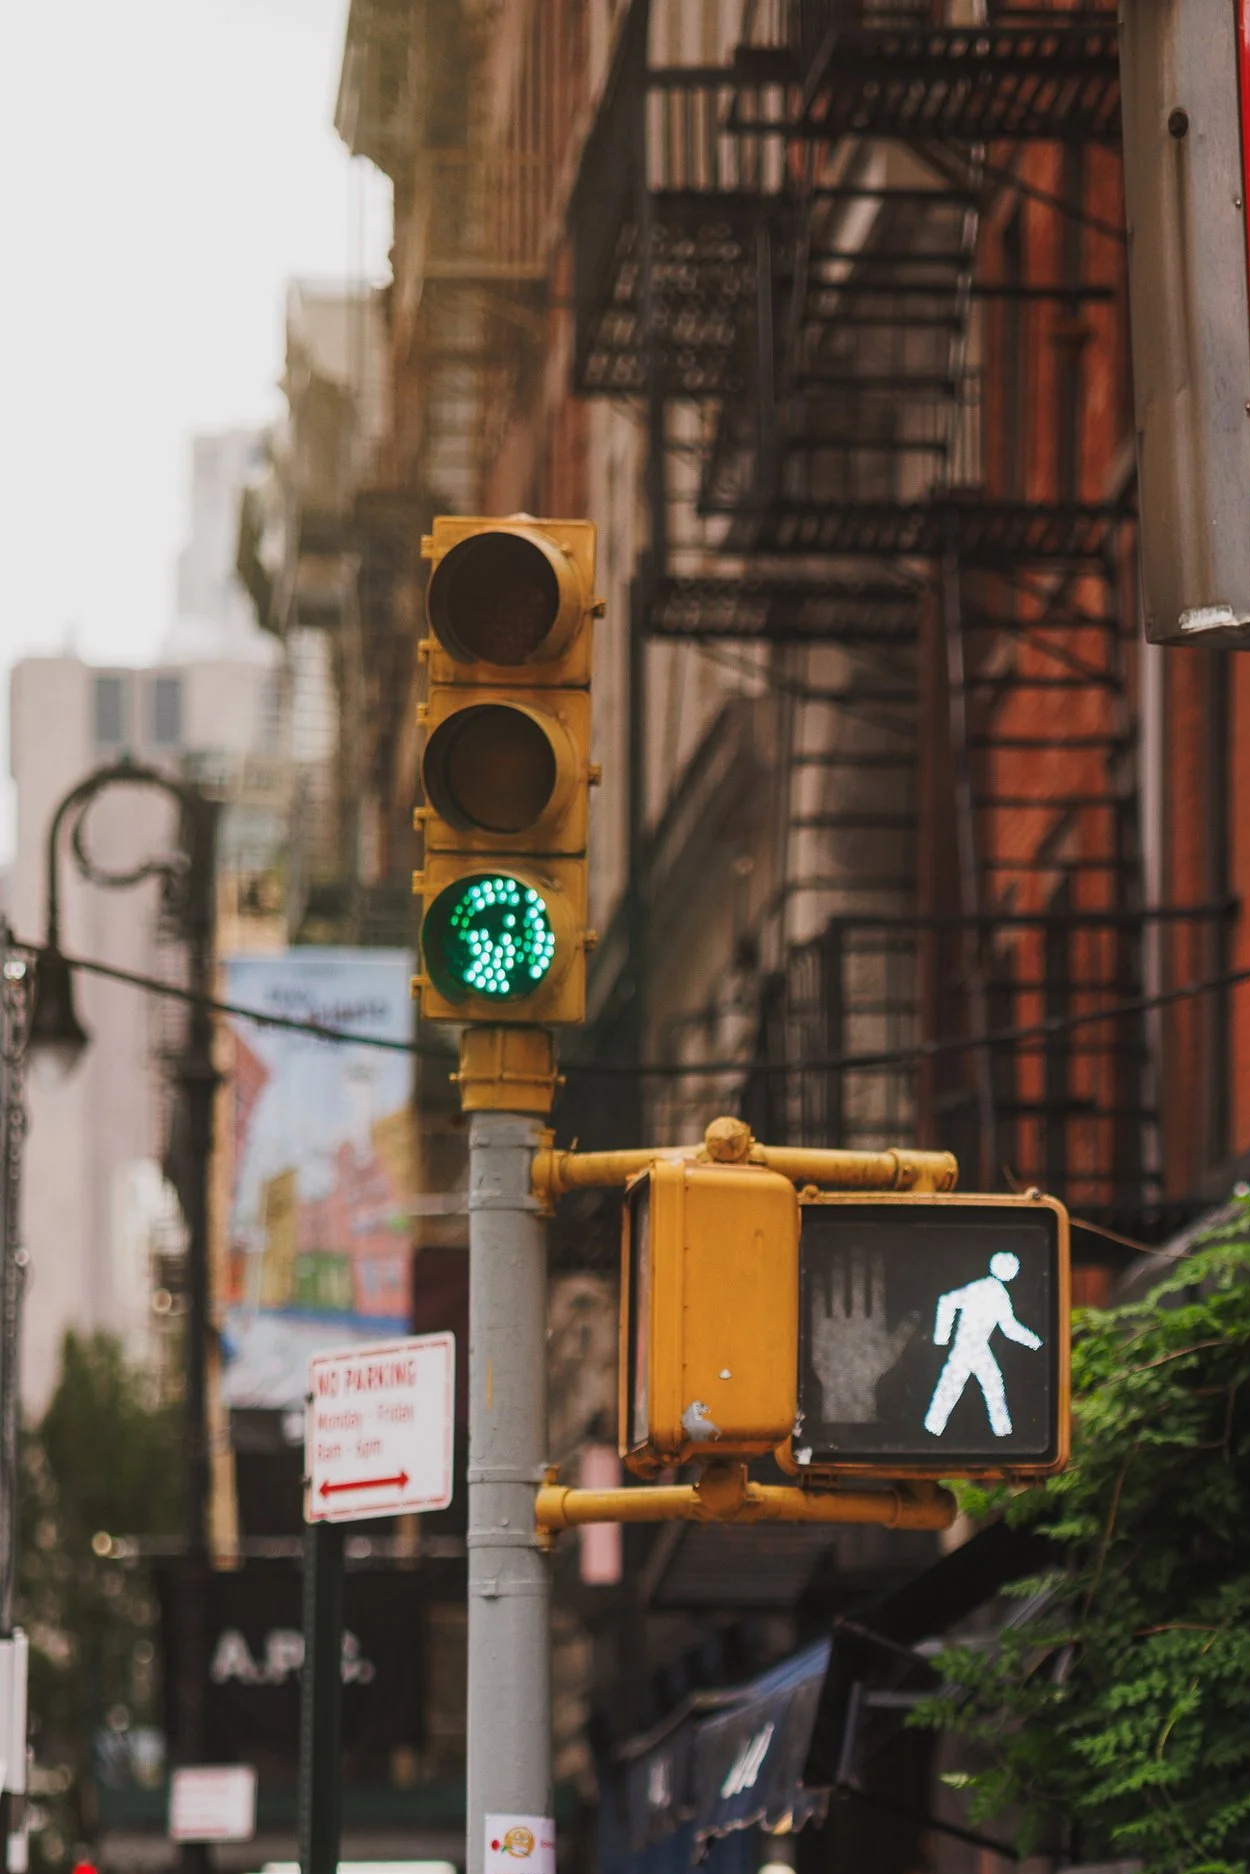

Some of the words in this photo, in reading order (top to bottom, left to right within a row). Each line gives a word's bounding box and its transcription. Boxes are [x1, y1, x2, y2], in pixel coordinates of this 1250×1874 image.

[318, 1371, 338, 1397] NO
[346, 1360, 416, 1391] PARKING
[318, 1408, 361, 1433] Monday
[377, 1404, 414, 1425] Friday
